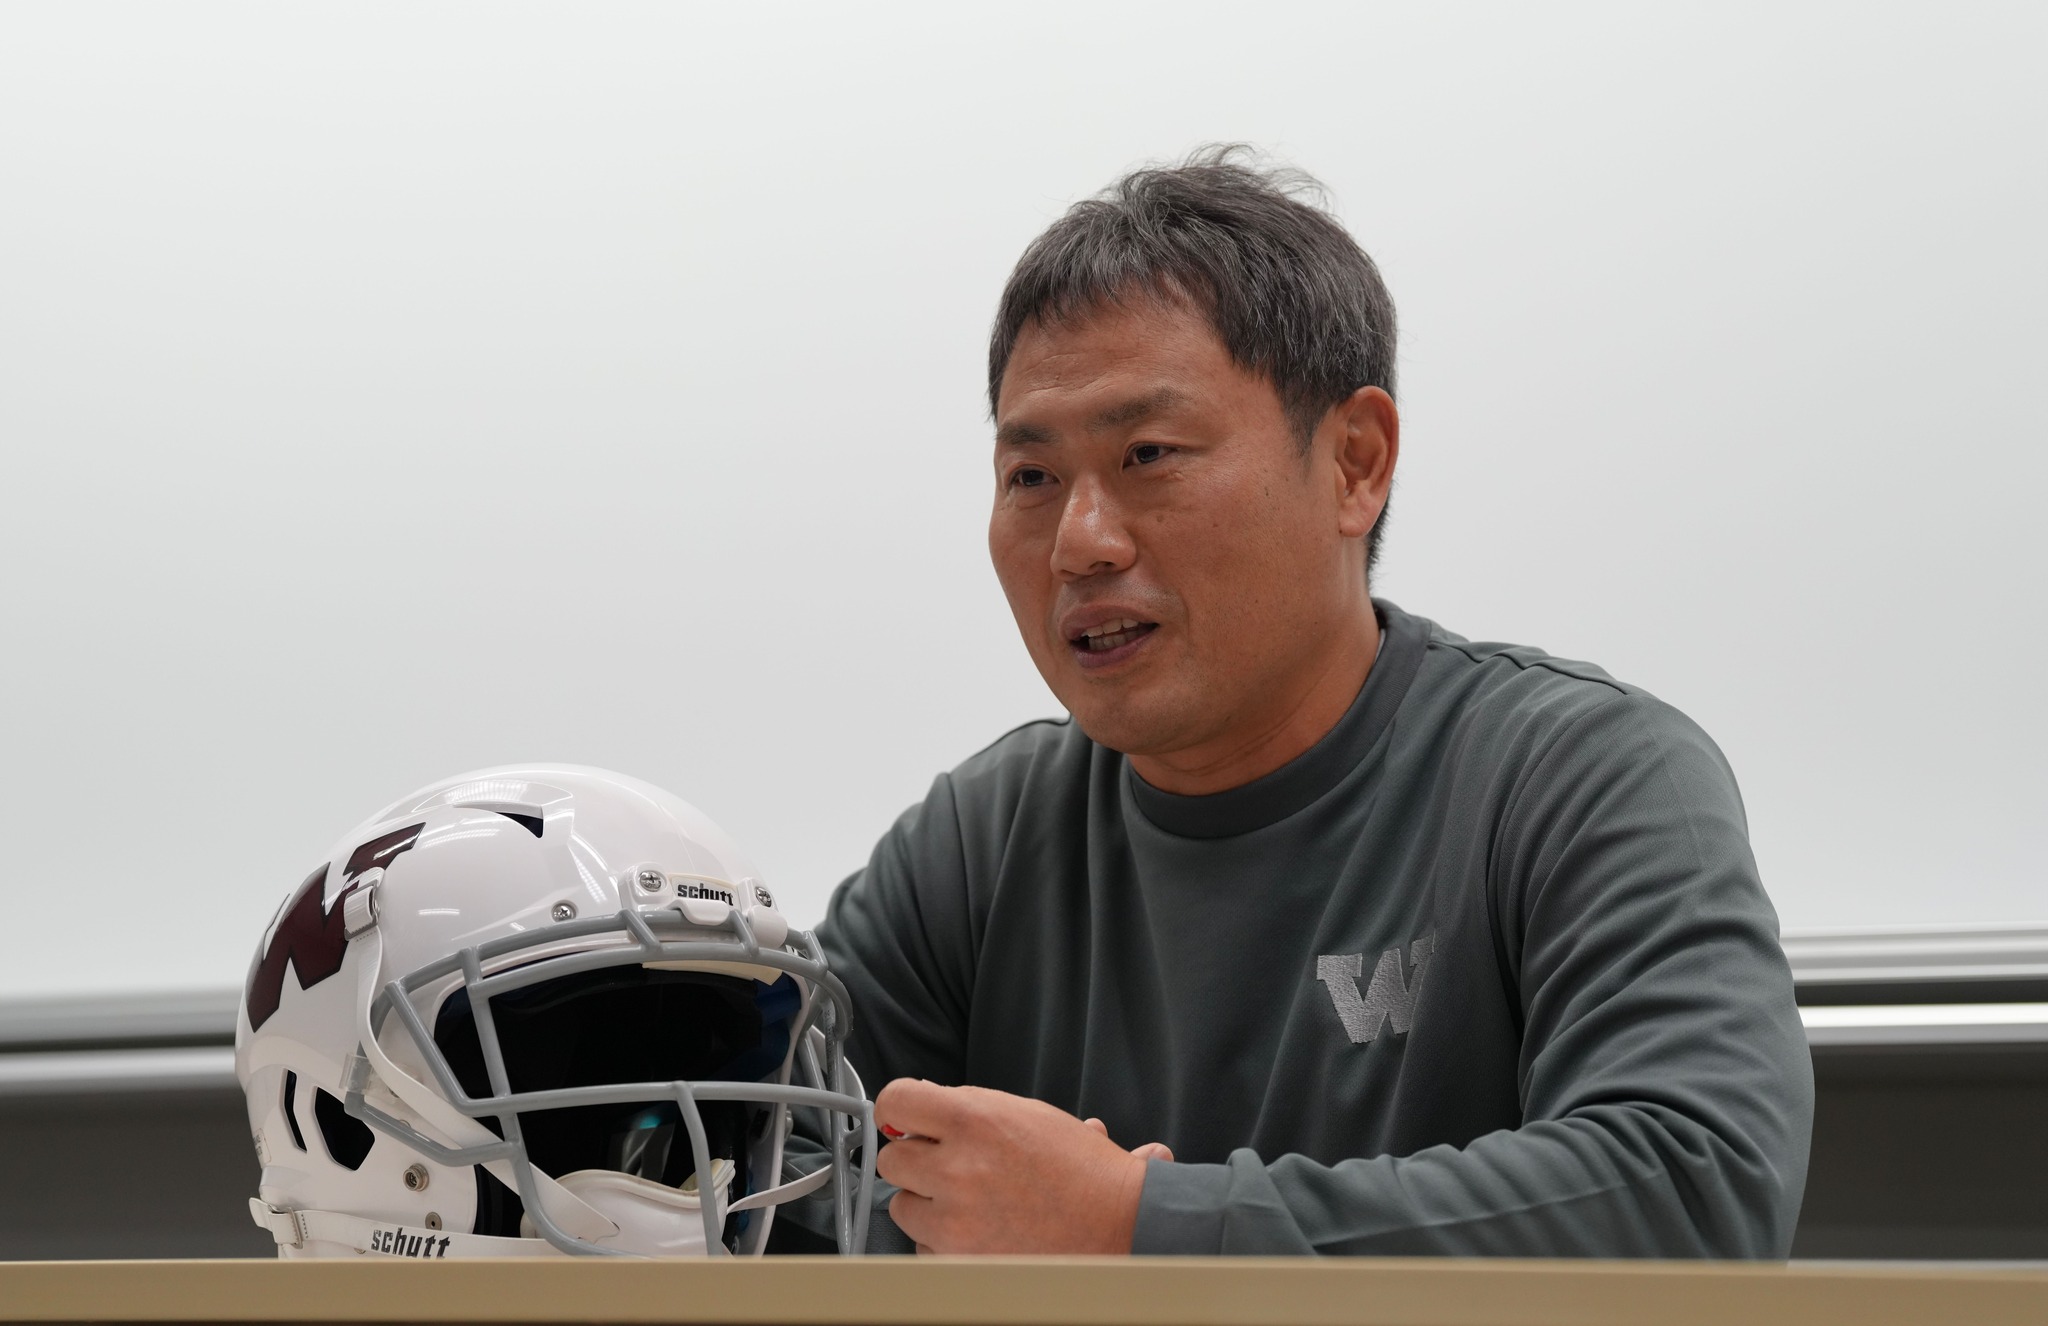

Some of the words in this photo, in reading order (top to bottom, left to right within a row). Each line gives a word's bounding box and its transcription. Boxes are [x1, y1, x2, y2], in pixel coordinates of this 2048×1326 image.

[677, 882, 734, 907] schutt
[1316, 929, 1435, 1044] W
[370, 1226, 451, 1259] schutt
